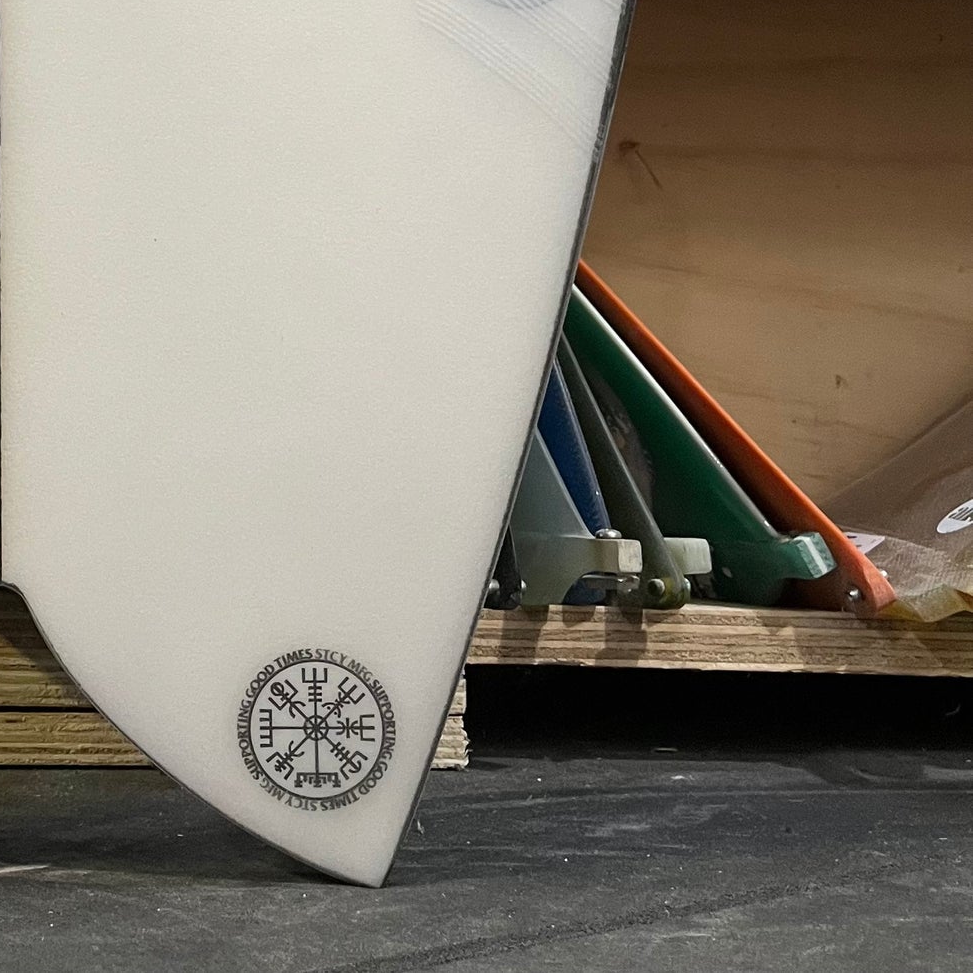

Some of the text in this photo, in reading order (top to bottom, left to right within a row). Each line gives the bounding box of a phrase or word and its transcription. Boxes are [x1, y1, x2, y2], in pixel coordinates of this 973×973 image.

[273, 648, 313, 668] TIMES
[245, 664, 275, 698] GOOD
[368, 679, 396, 761] SUPPORTING
[237, 699, 264, 780] SUPPORTING
[358, 761, 388, 796] GOOD
[320, 793, 360, 811] TIMES
